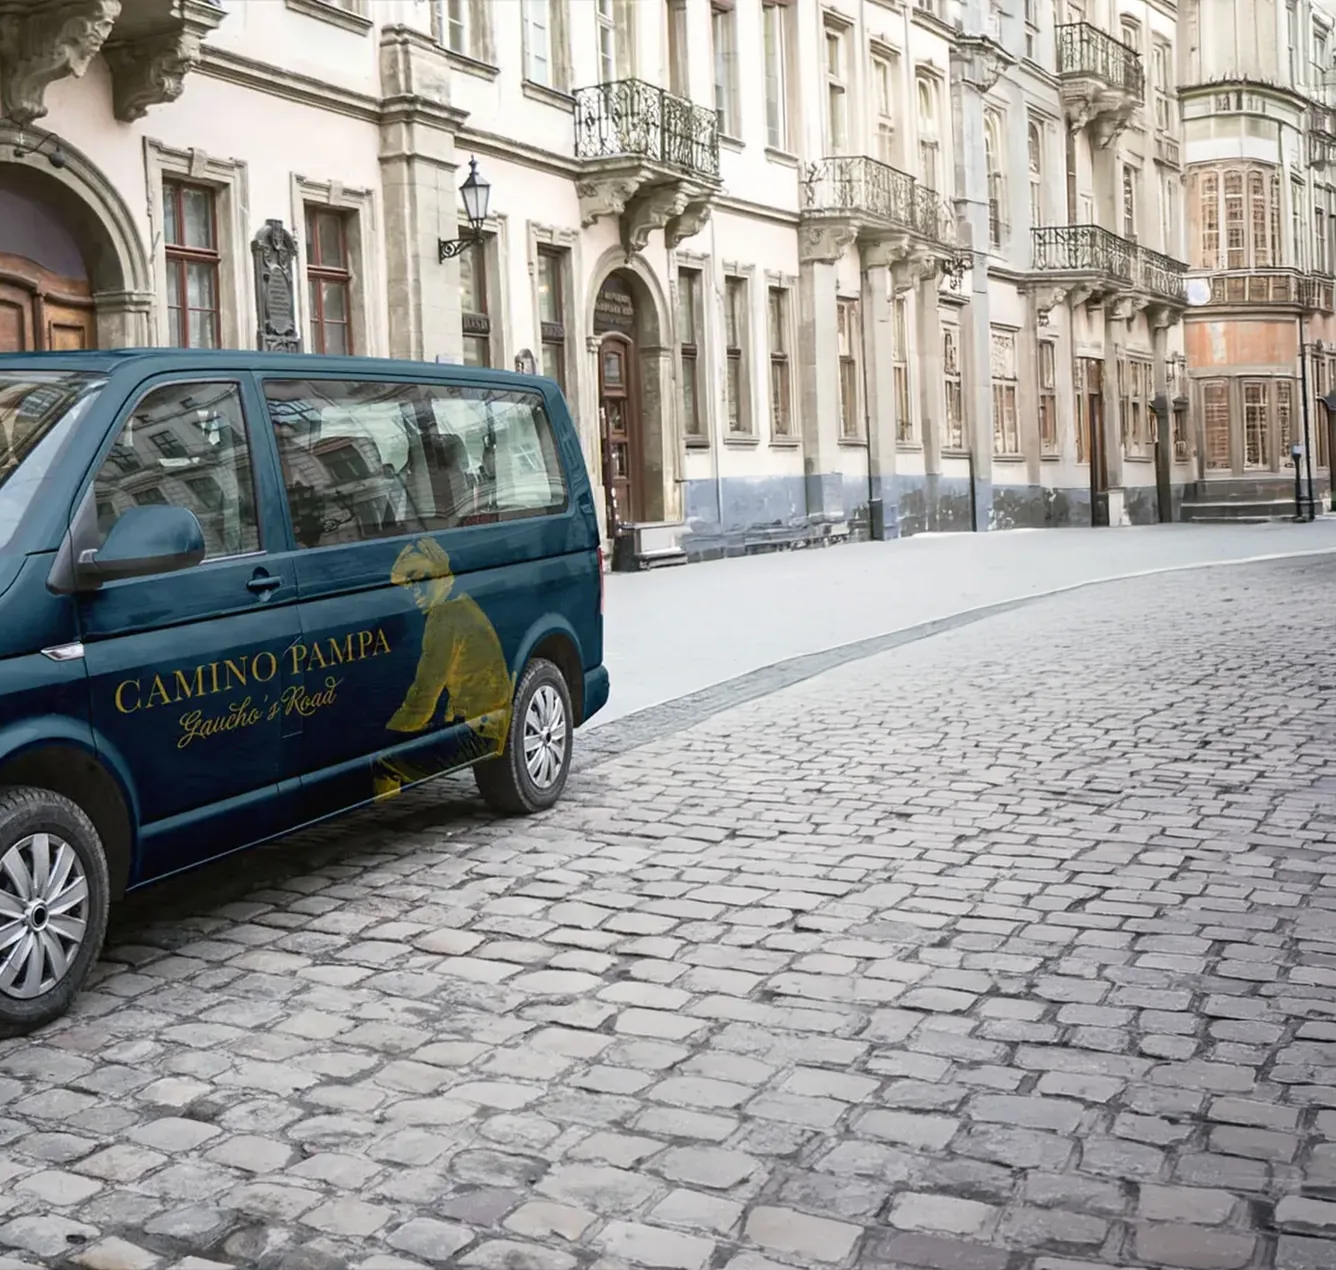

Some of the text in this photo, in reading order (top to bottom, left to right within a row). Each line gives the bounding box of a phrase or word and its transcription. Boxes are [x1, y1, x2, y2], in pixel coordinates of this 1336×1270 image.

[114, 627, 392, 714] CAMINO PAMPA
[280, 676, 345, 717] Road
